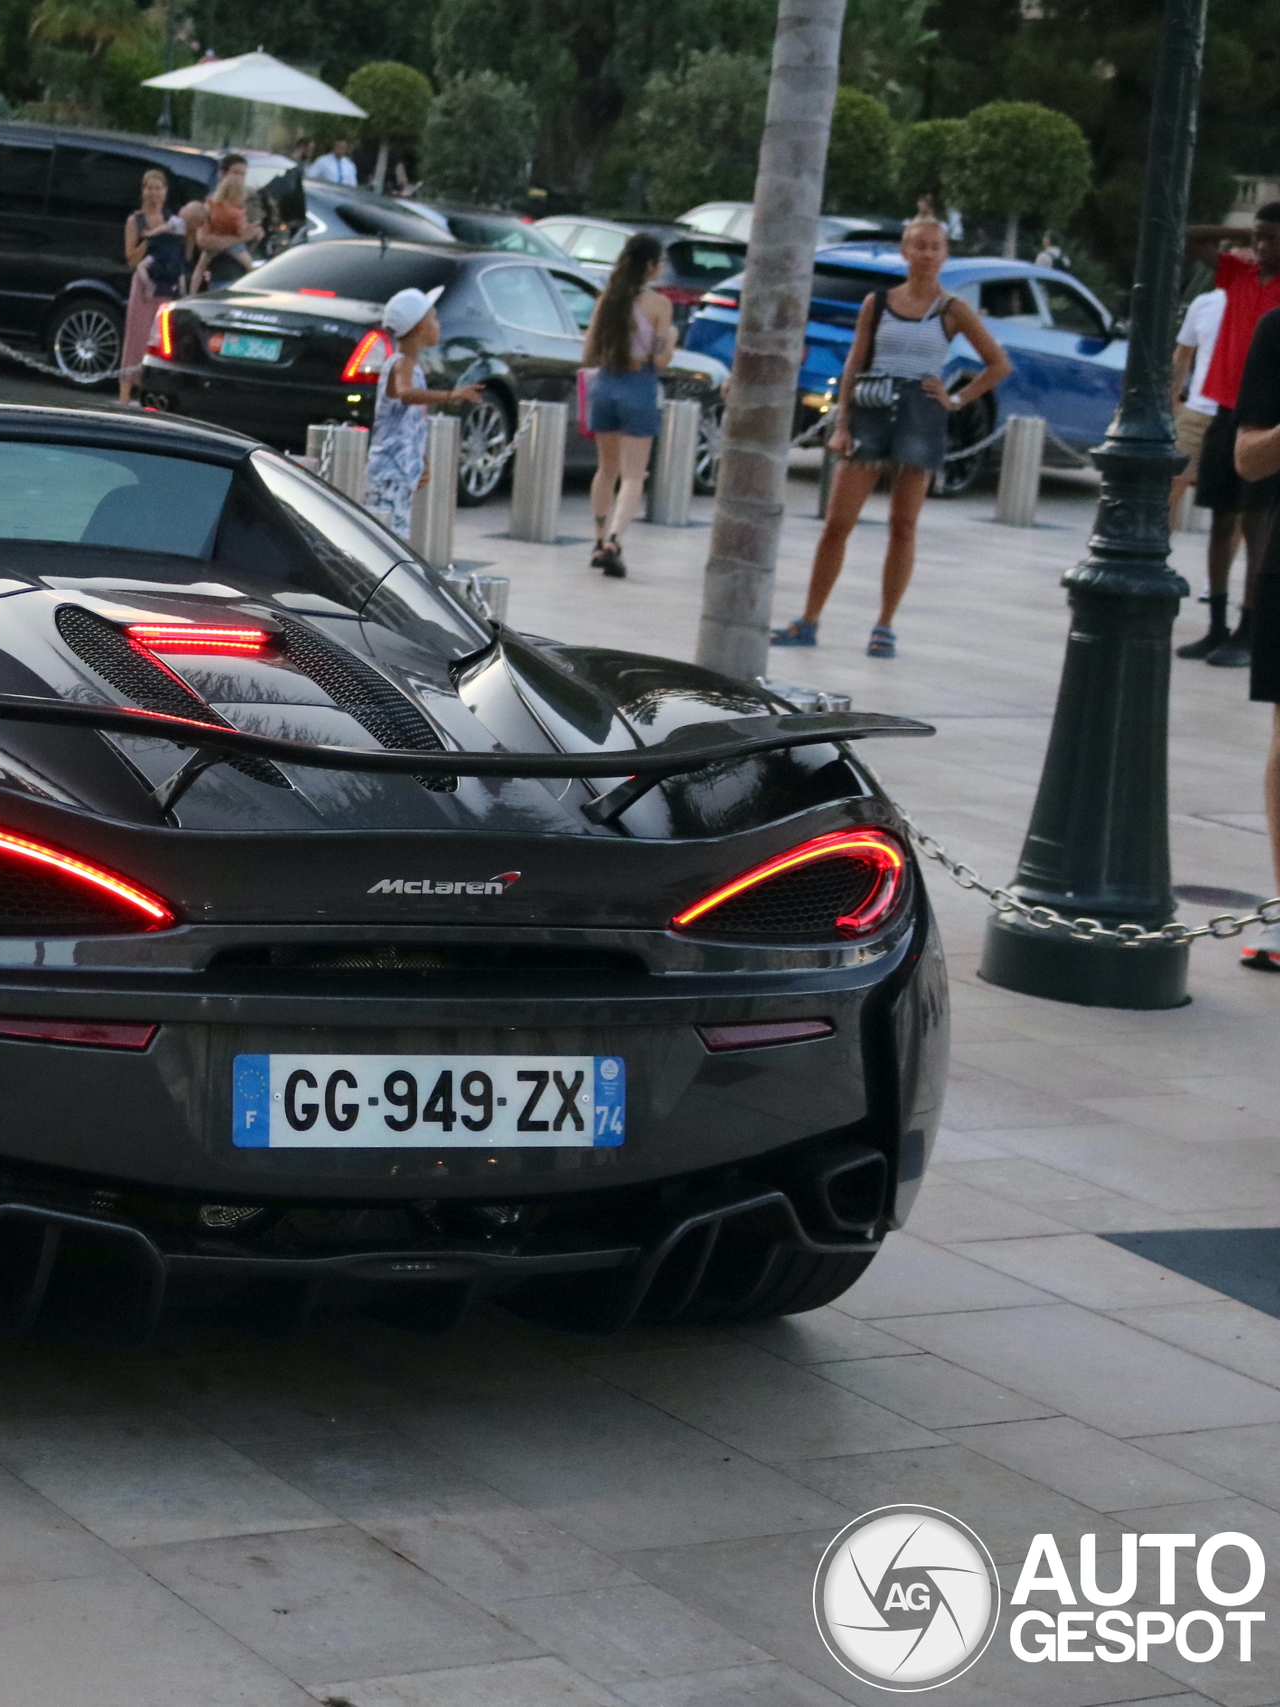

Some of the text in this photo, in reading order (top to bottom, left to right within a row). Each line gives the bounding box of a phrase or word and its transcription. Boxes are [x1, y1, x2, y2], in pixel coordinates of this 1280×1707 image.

[366, 879, 503, 895] McLaren
[284, 1069, 584, 1132] GG-949-ZX
[246, 1111, 257, 1129] F
[596, 1106, 623, 1135] 74
